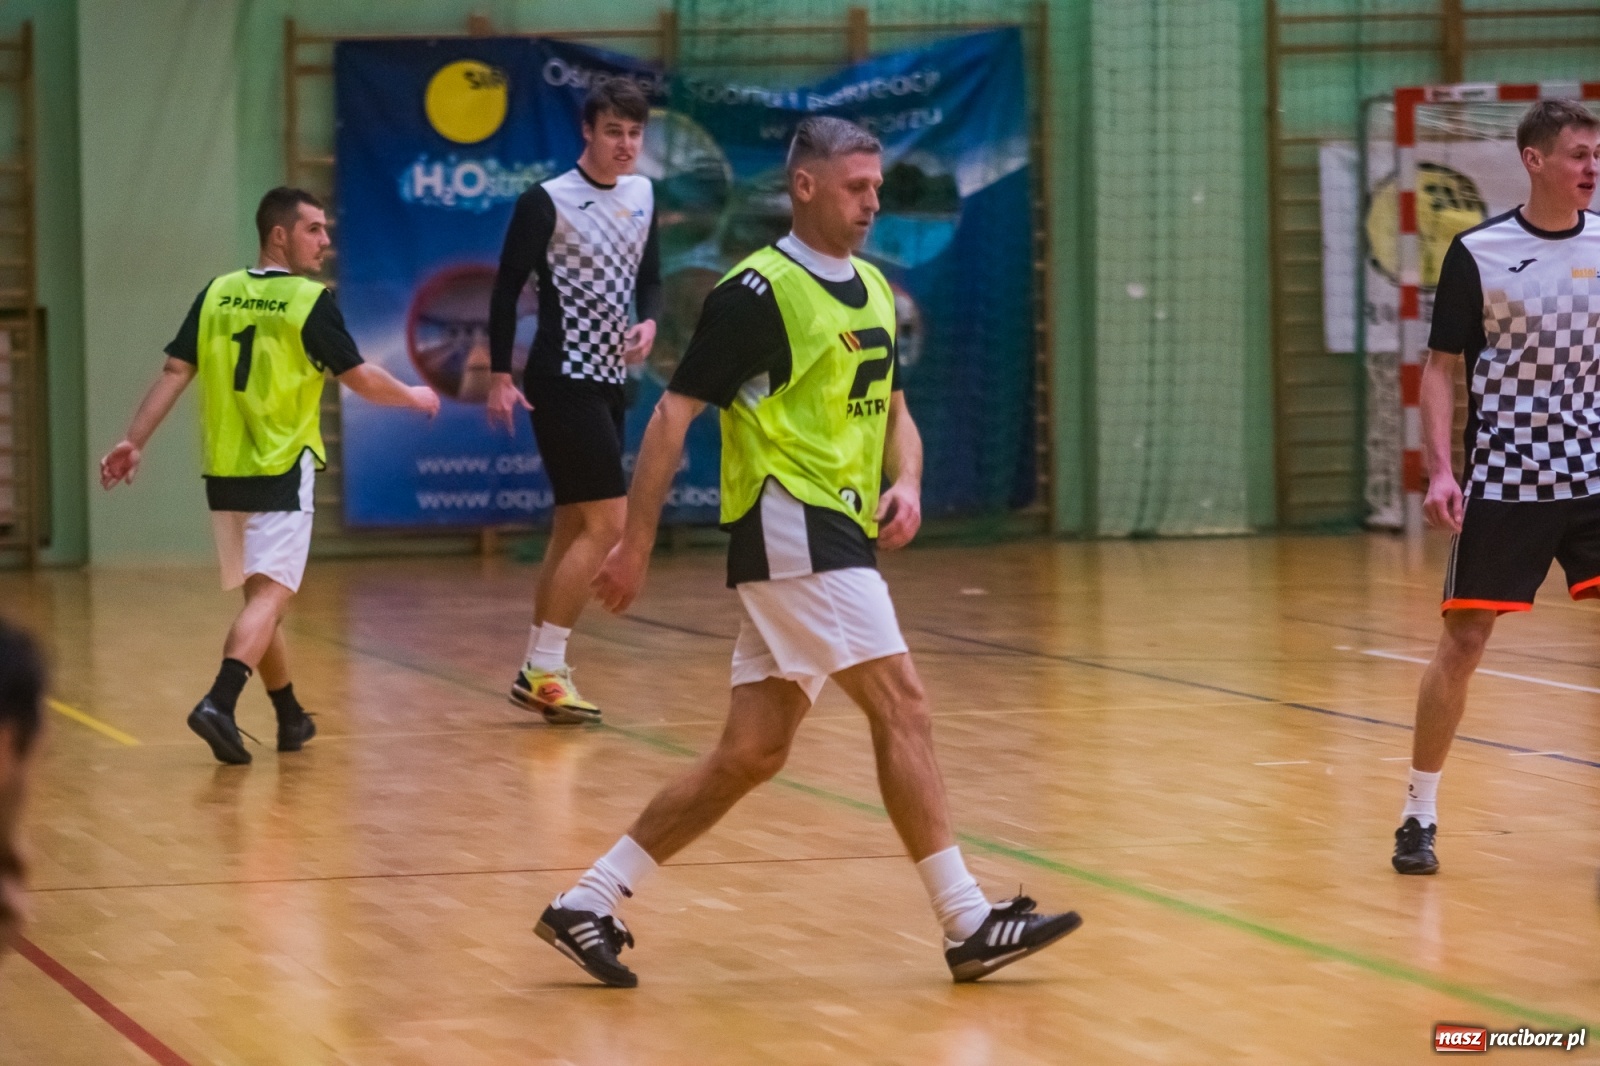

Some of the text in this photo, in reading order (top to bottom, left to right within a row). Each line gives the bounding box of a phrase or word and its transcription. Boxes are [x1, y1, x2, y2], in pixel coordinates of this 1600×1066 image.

[232, 297, 288, 313] PATRICK
[231, 324, 257, 393] 1
[846, 397, 889, 420] PATR
